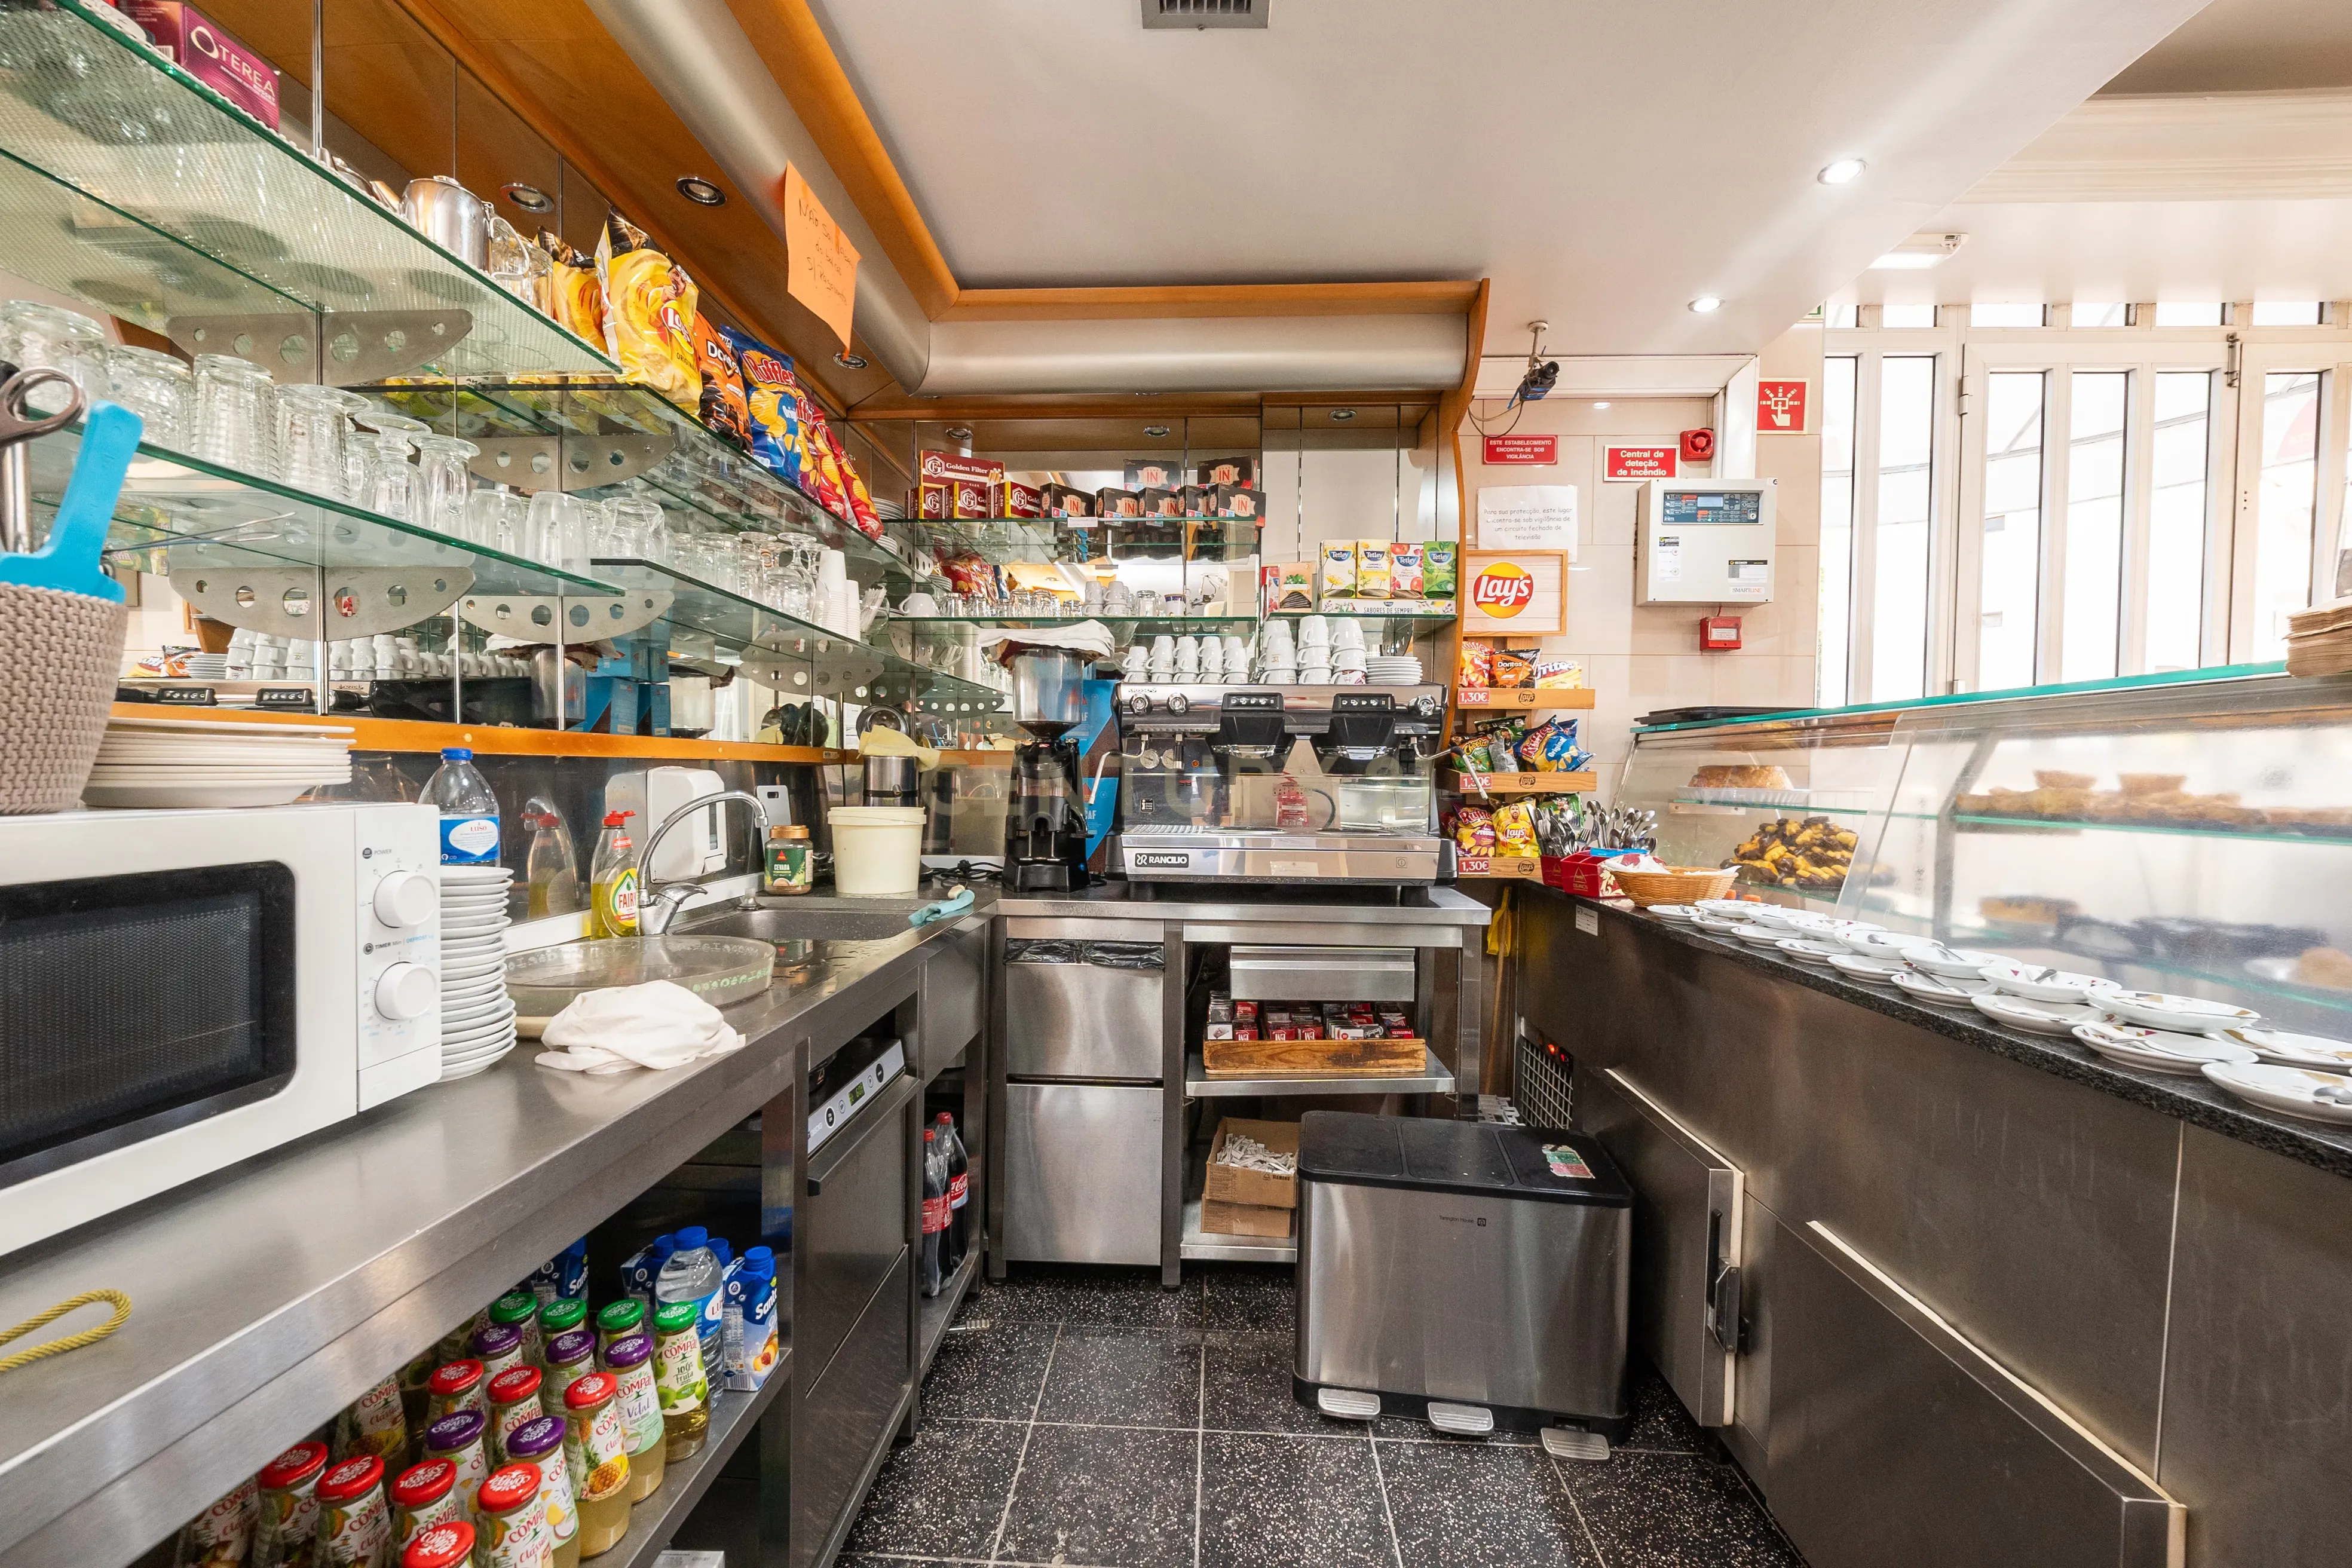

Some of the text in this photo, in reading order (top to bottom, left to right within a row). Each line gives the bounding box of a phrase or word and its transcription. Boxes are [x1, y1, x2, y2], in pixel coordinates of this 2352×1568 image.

[743, 352, 796, 391] Ruffles
[946, 463, 970, 472] Golden
[971, 466, 989, 474] Filter
[1625, 460, 1659, 468] deteção
[1219, 470, 1230, 481] IN
[1631, 467, 1667, 476] incêndio
[1070, 500, 1079, 512] IN
[1125, 502, 1135, 514] IN
[1167, 502, 1177, 514] IN
[1238, 500, 1247, 512] IN
[1398, 556, 1416, 565] Tetley
[1432, 553, 1449, 561] Tetley
[1476, 575, 1532, 607] Lay's
[1460, 692, 1487, 703] 1,30€
[1520, 723, 1554, 758] Ruffles
[1464, 739, 1489, 756] Cheetos
[1547, 736, 1566, 758] Original
[1149, 856, 1187, 864] RANCILIO
[1461, 860, 1489, 872] 1,30€
[406, 934, 427, 943] DEFROST
[627, 1396, 652, 1418] Vital
